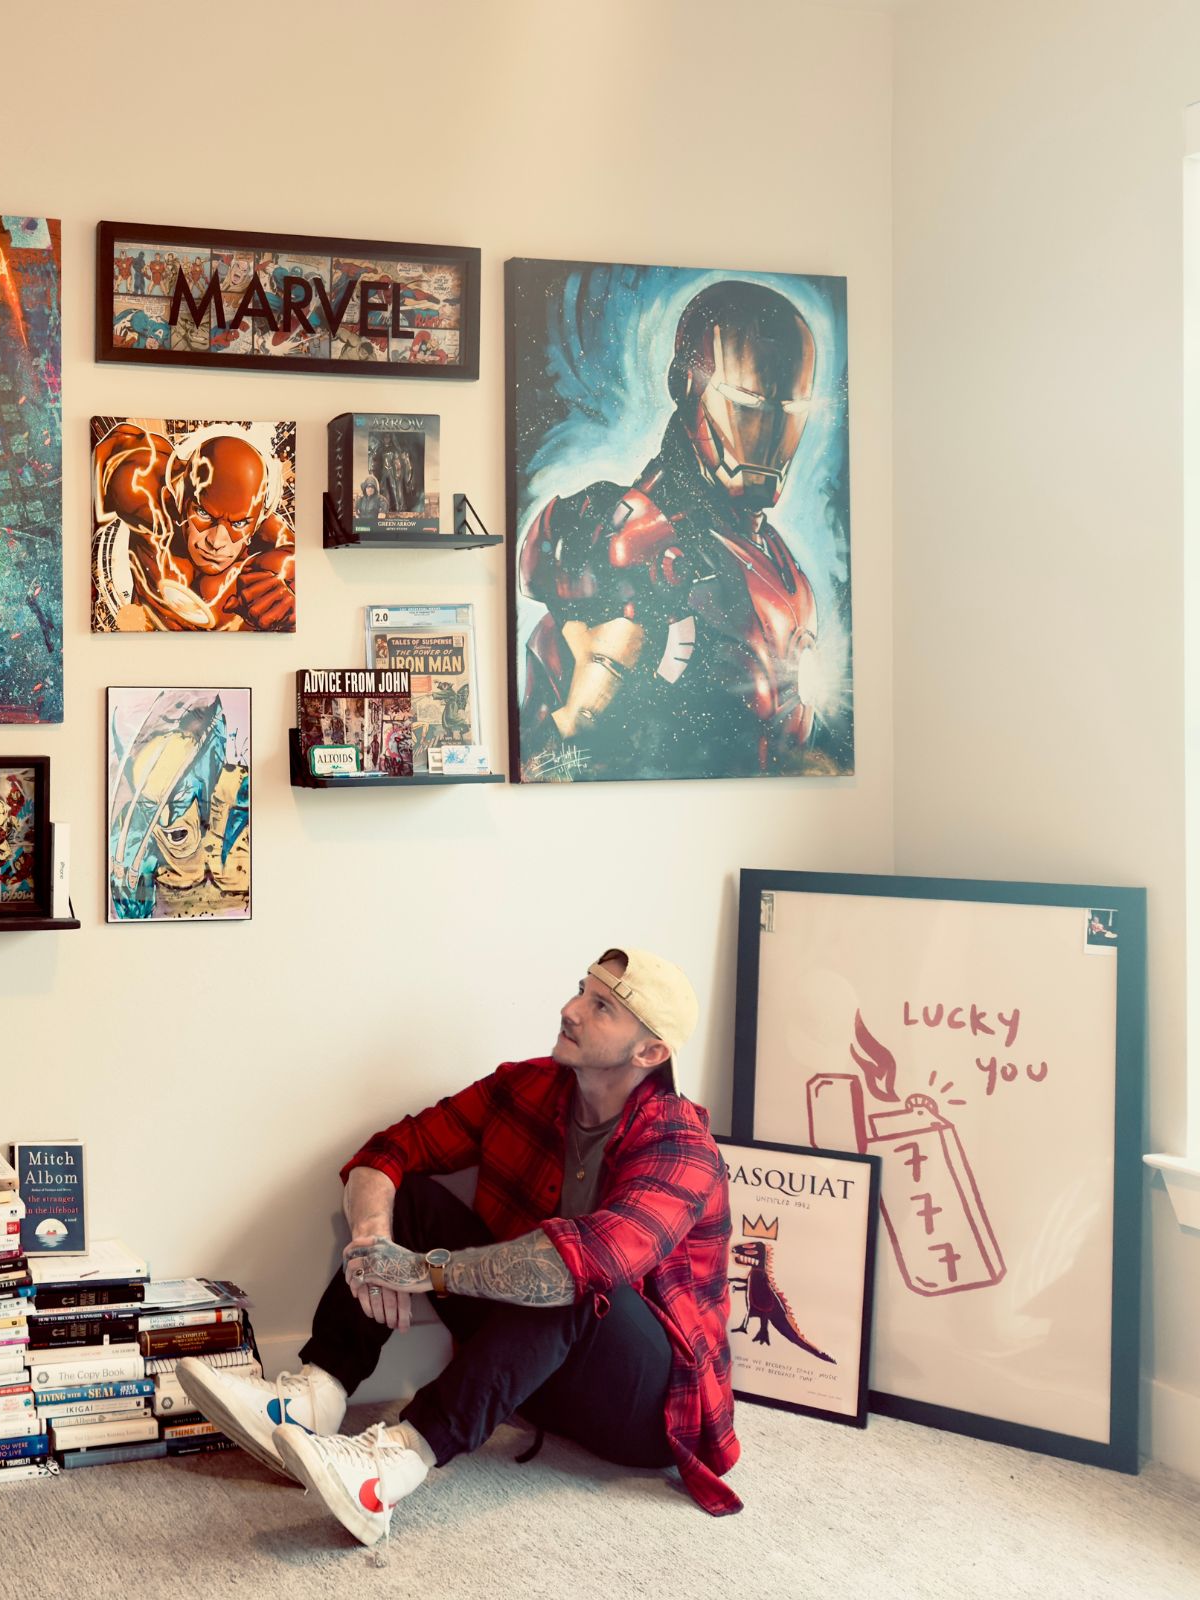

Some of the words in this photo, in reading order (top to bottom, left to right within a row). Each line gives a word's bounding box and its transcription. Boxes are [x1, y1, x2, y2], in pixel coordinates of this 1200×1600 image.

[169, 264, 415, 339] MARVEL
[372, 416, 425, 430] ARROW
[374, 613, 389, 622] 2.0
[391, 656, 425, 673] IRON
[428, 656, 462, 673] MAN
[304, 671, 342, 693] ADVICE
[345, 671, 376, 693] FROM
[378, 671, 409, 693] JOHN
[317, 752, 354, 764] ALTOIDS
[28, 1151, 75, 1166] Mitch
[894, 1142, 928, 1183] 7
[24, 1170, 78, 1184] Albom
[42, 1195, 74, 1203] stranger
[910, 1192, 943, 1235] 7
[927, 1242, 961, 1283] 7
[58, 1372, 75, 1381] The
[77, 1370, 100, 1380] Copy
[102, 1368, 125, 1378] Book
[66, 1405, 93, 1414] IKIGAI
[170, 1429, 196, 1437] THINK
